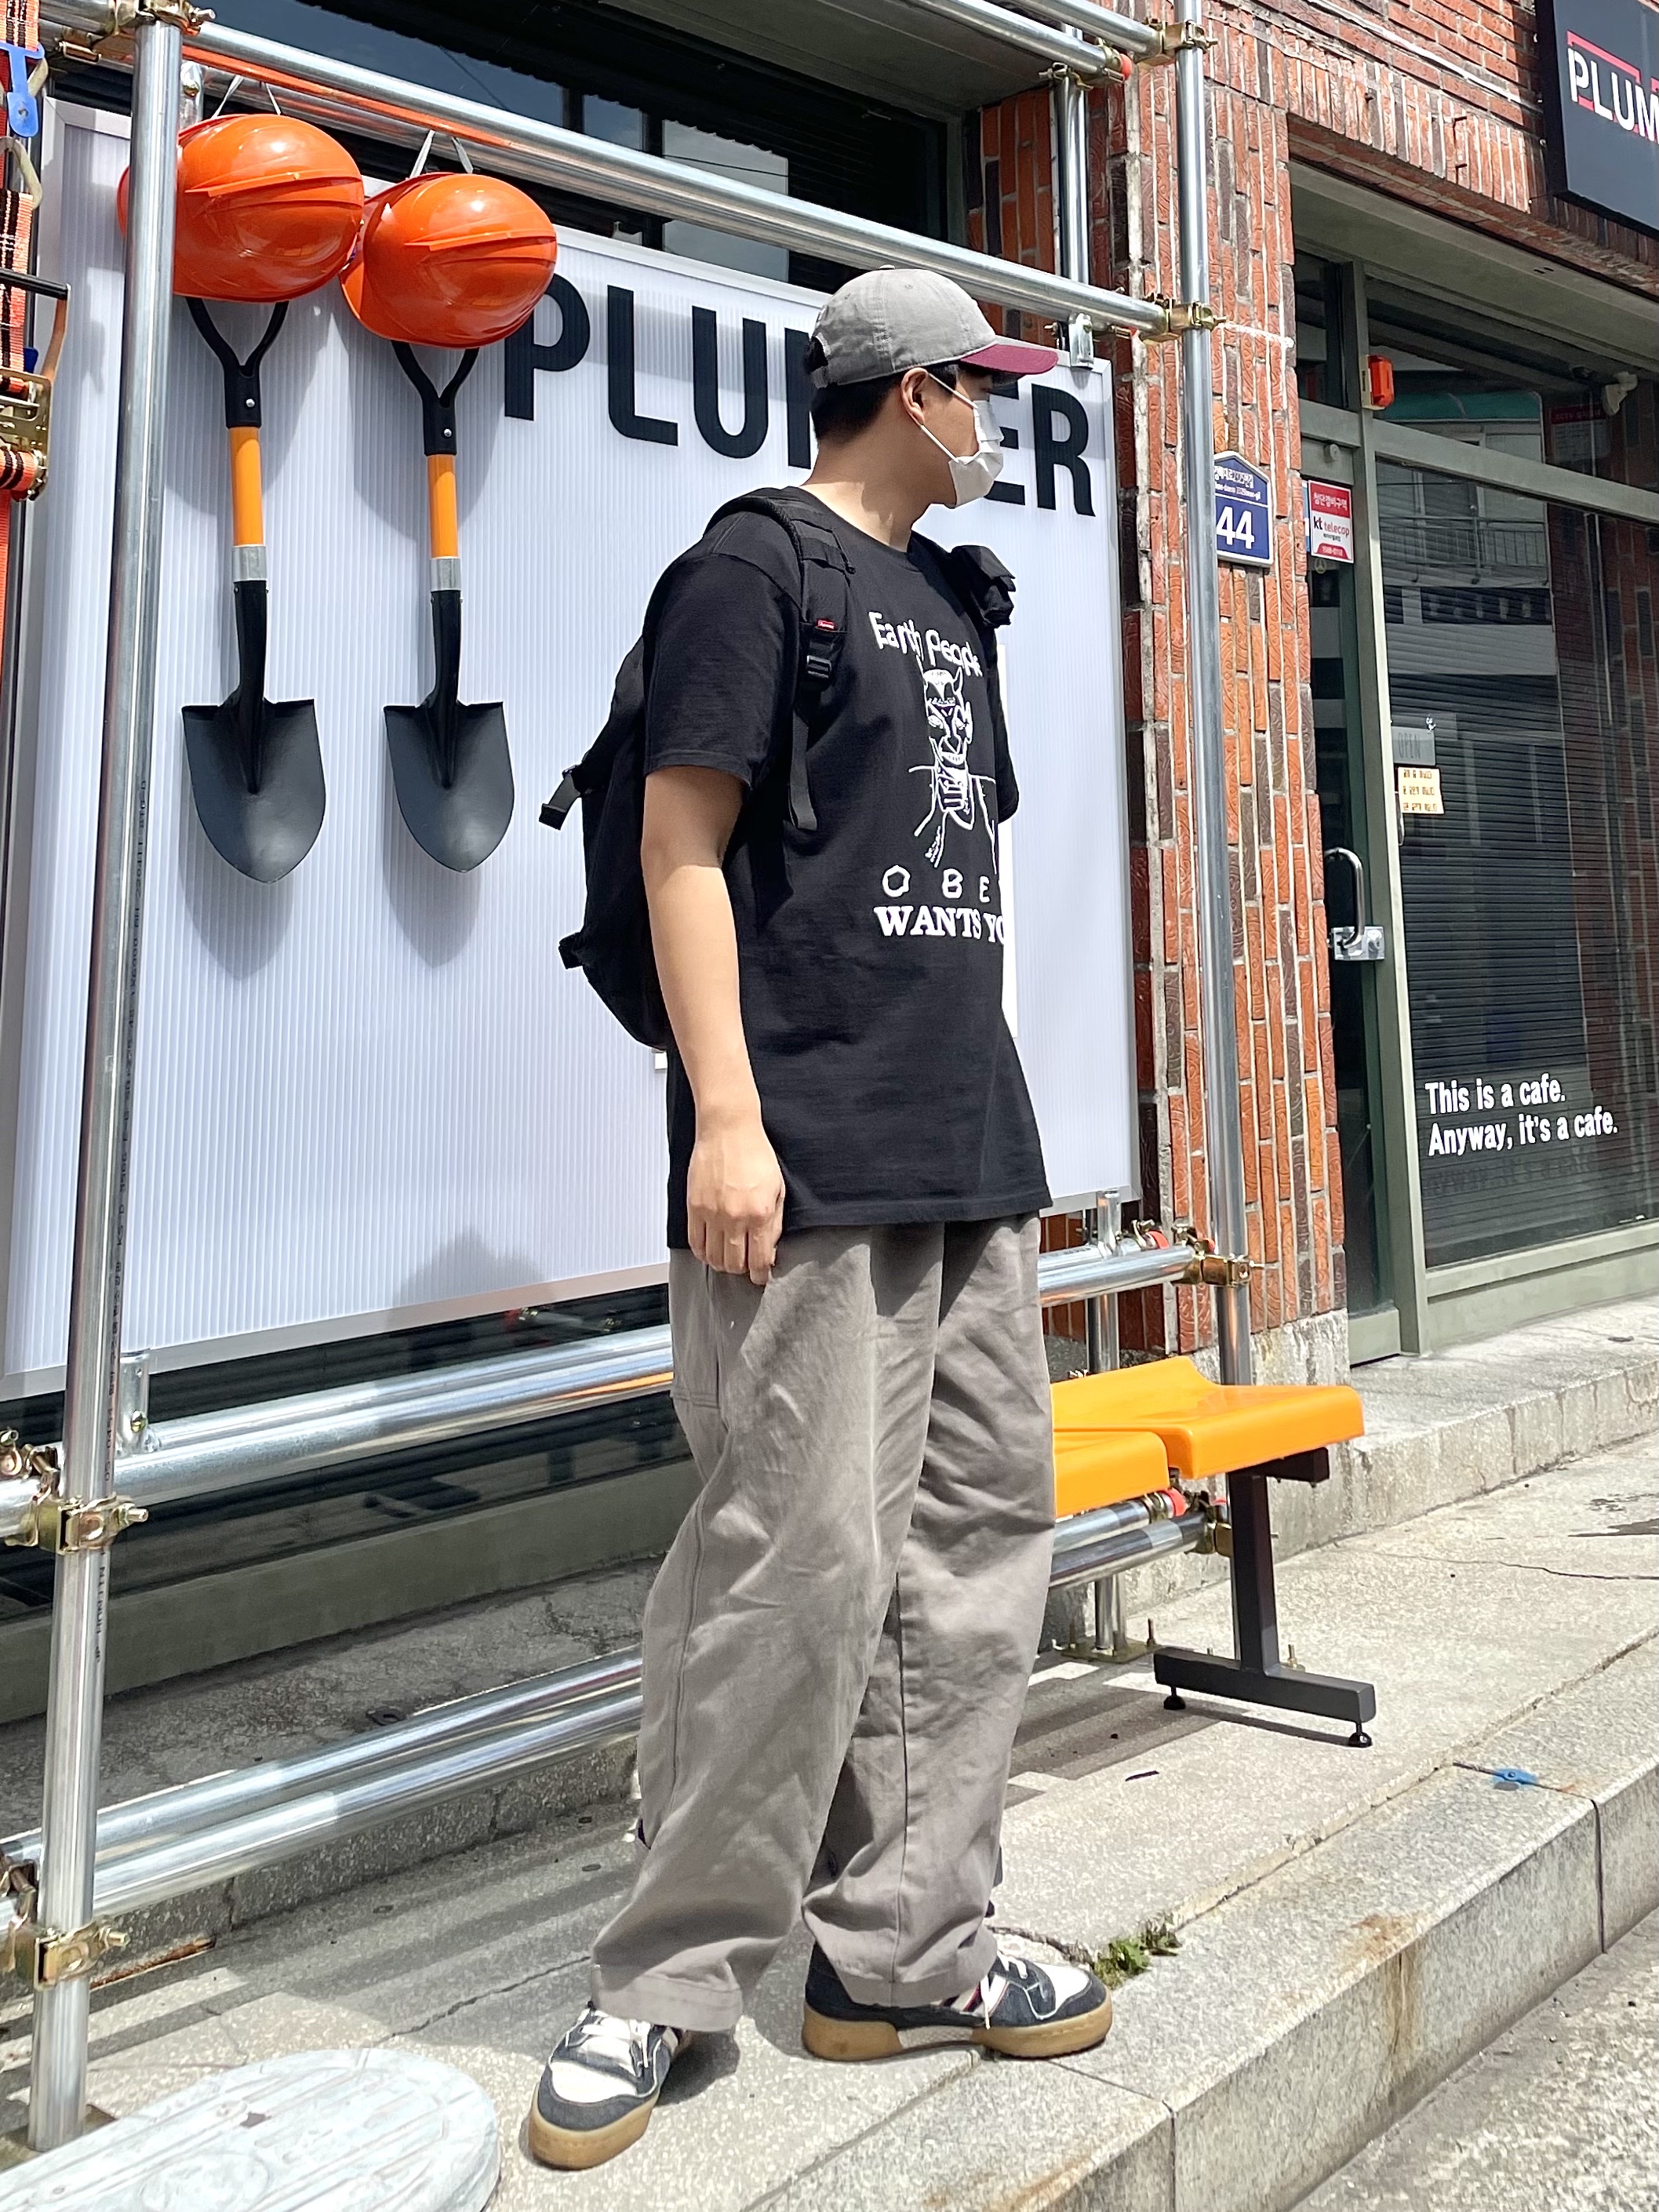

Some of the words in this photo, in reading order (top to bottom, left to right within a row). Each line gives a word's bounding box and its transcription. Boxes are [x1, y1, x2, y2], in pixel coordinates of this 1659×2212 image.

[1568, 48, 1659, 144] PLUM
[504, 273, 1096, 517] PLUR
[1217, 506, 1255, 549] 44
[1313, 515, 1322, 530] kt
[1324, 521, 1350, 538] telecop
[868, 611, 924, 661] Earth
[1399, 733, 1421, 759] OPEN
[873, 905, 981, 940] WANTS
[1424, 1079, 1470, 1115] This
[1475, 1078, 1494, 1111] is
[1501, 1082, 1513, 1108] a
[1519, 1072, 1566, 1106] cafe.
[1428, 1122, 1513, 1156] Anyway,
[1519, 1113, 1551, 1144] it's
[1556, 1116, 1570, 1140] a
[1574, 1105, 1618, 1138] cafe.
